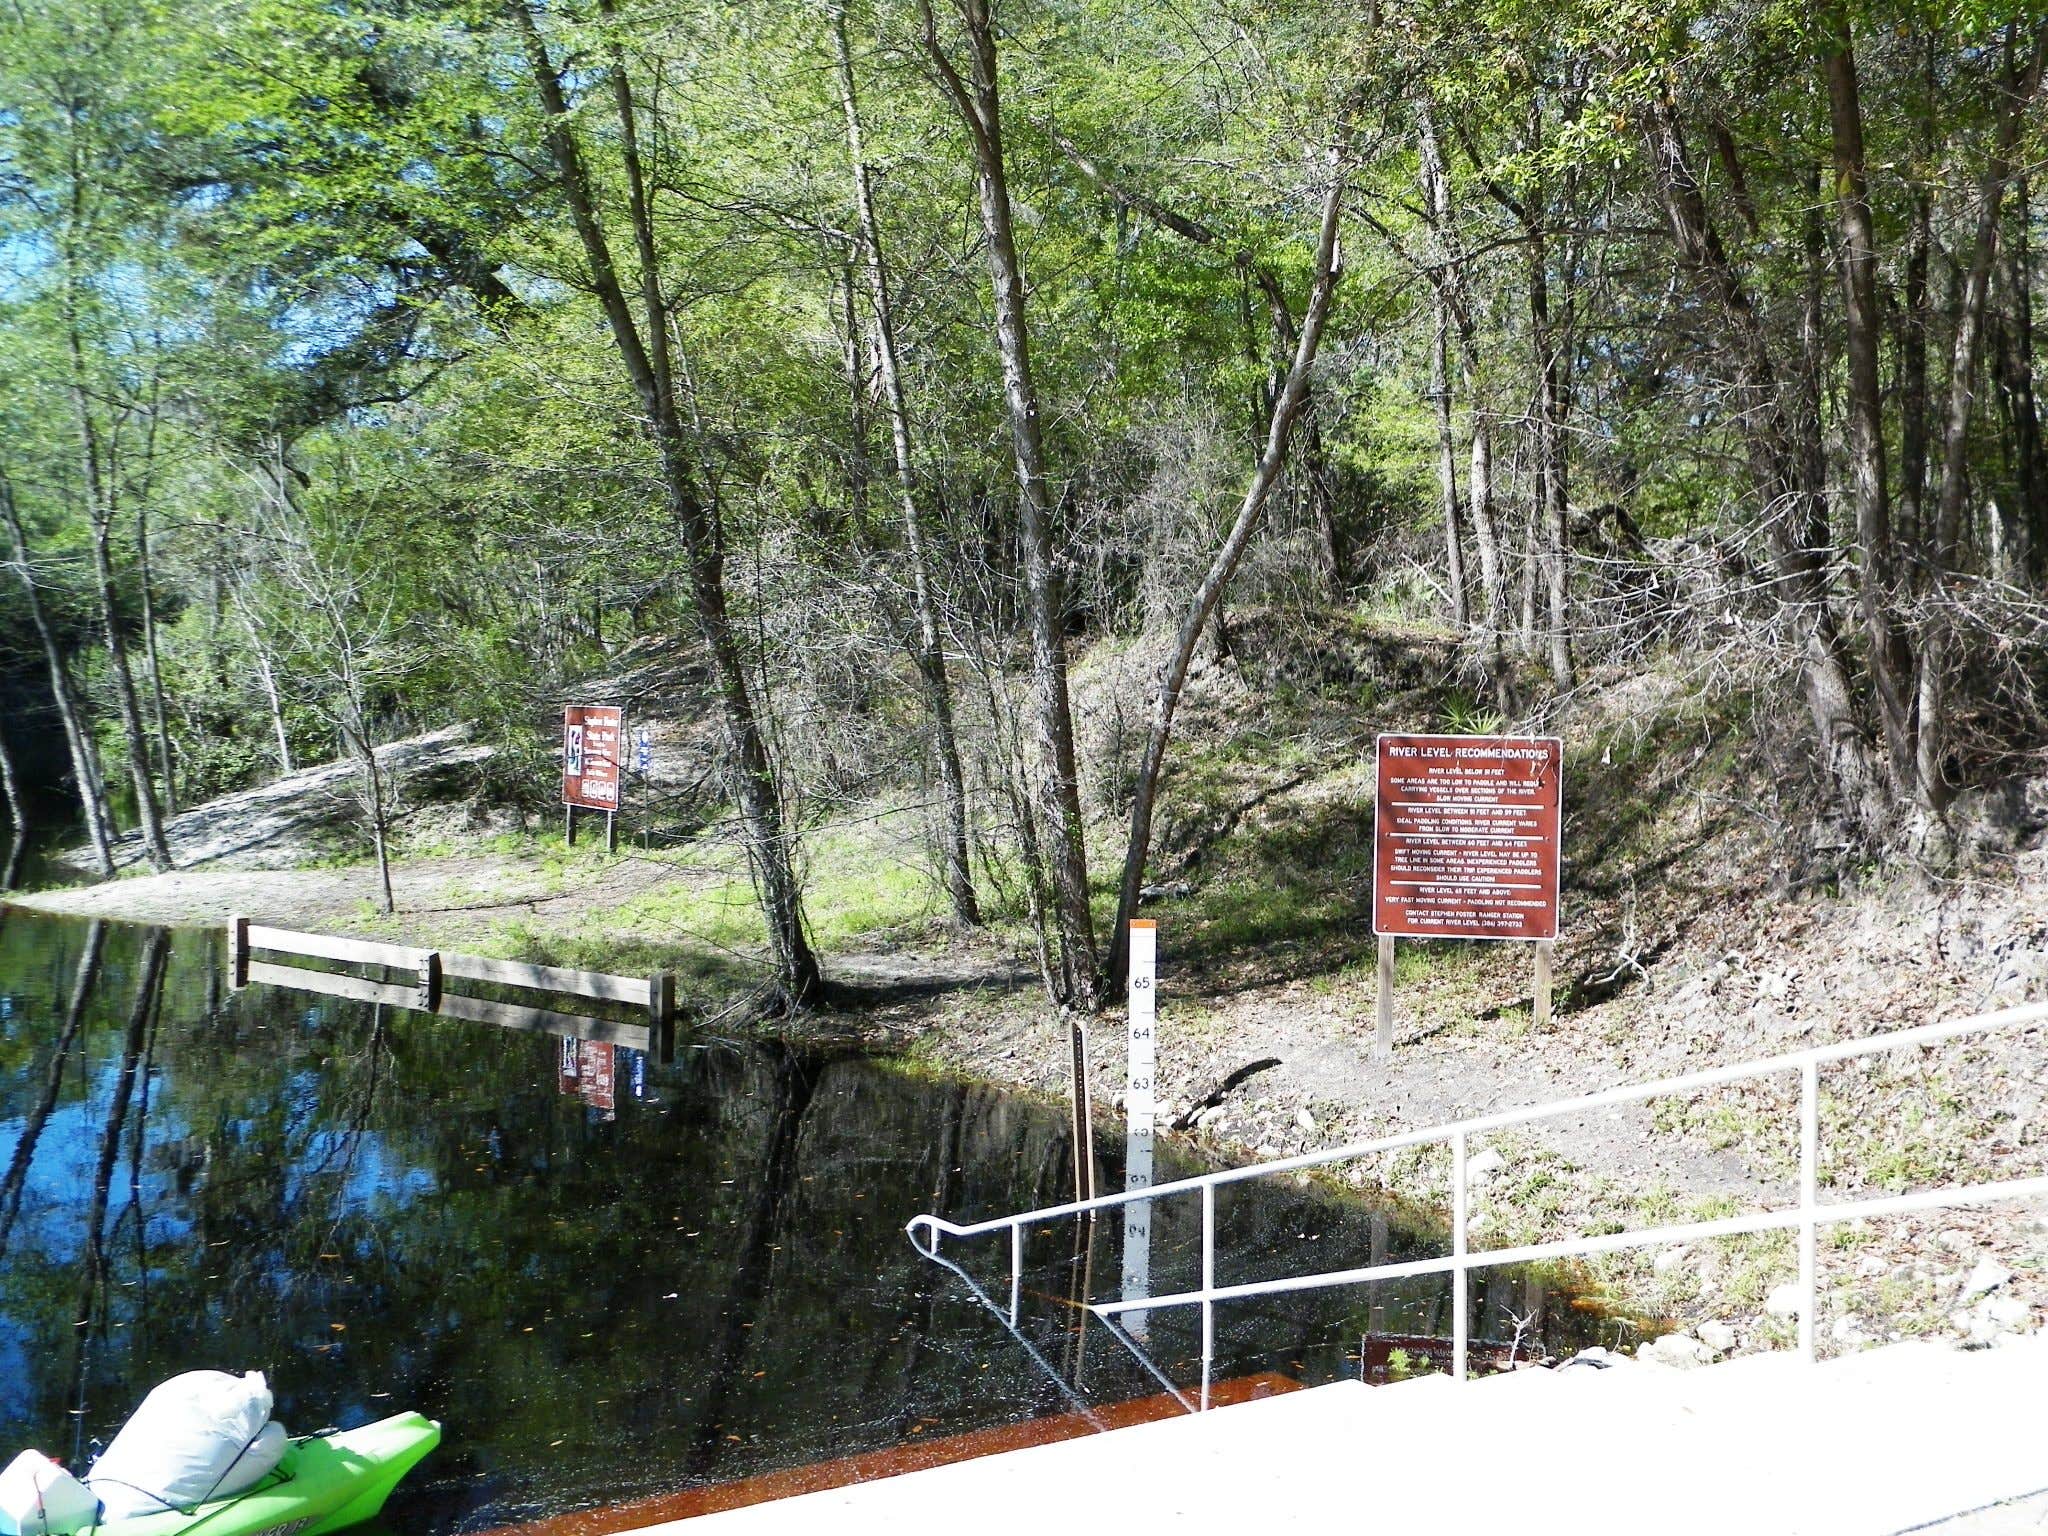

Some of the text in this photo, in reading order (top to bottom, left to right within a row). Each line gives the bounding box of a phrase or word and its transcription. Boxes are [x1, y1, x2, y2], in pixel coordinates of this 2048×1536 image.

[1390, 747, 1548, 759] RIVER LEVEL RECOMMENDATIONS
[1134, 977, 1150, 988] 65
[1134, 1028, 1149, 1039] 64
[1134, 1078, 1148, 1089] 63
